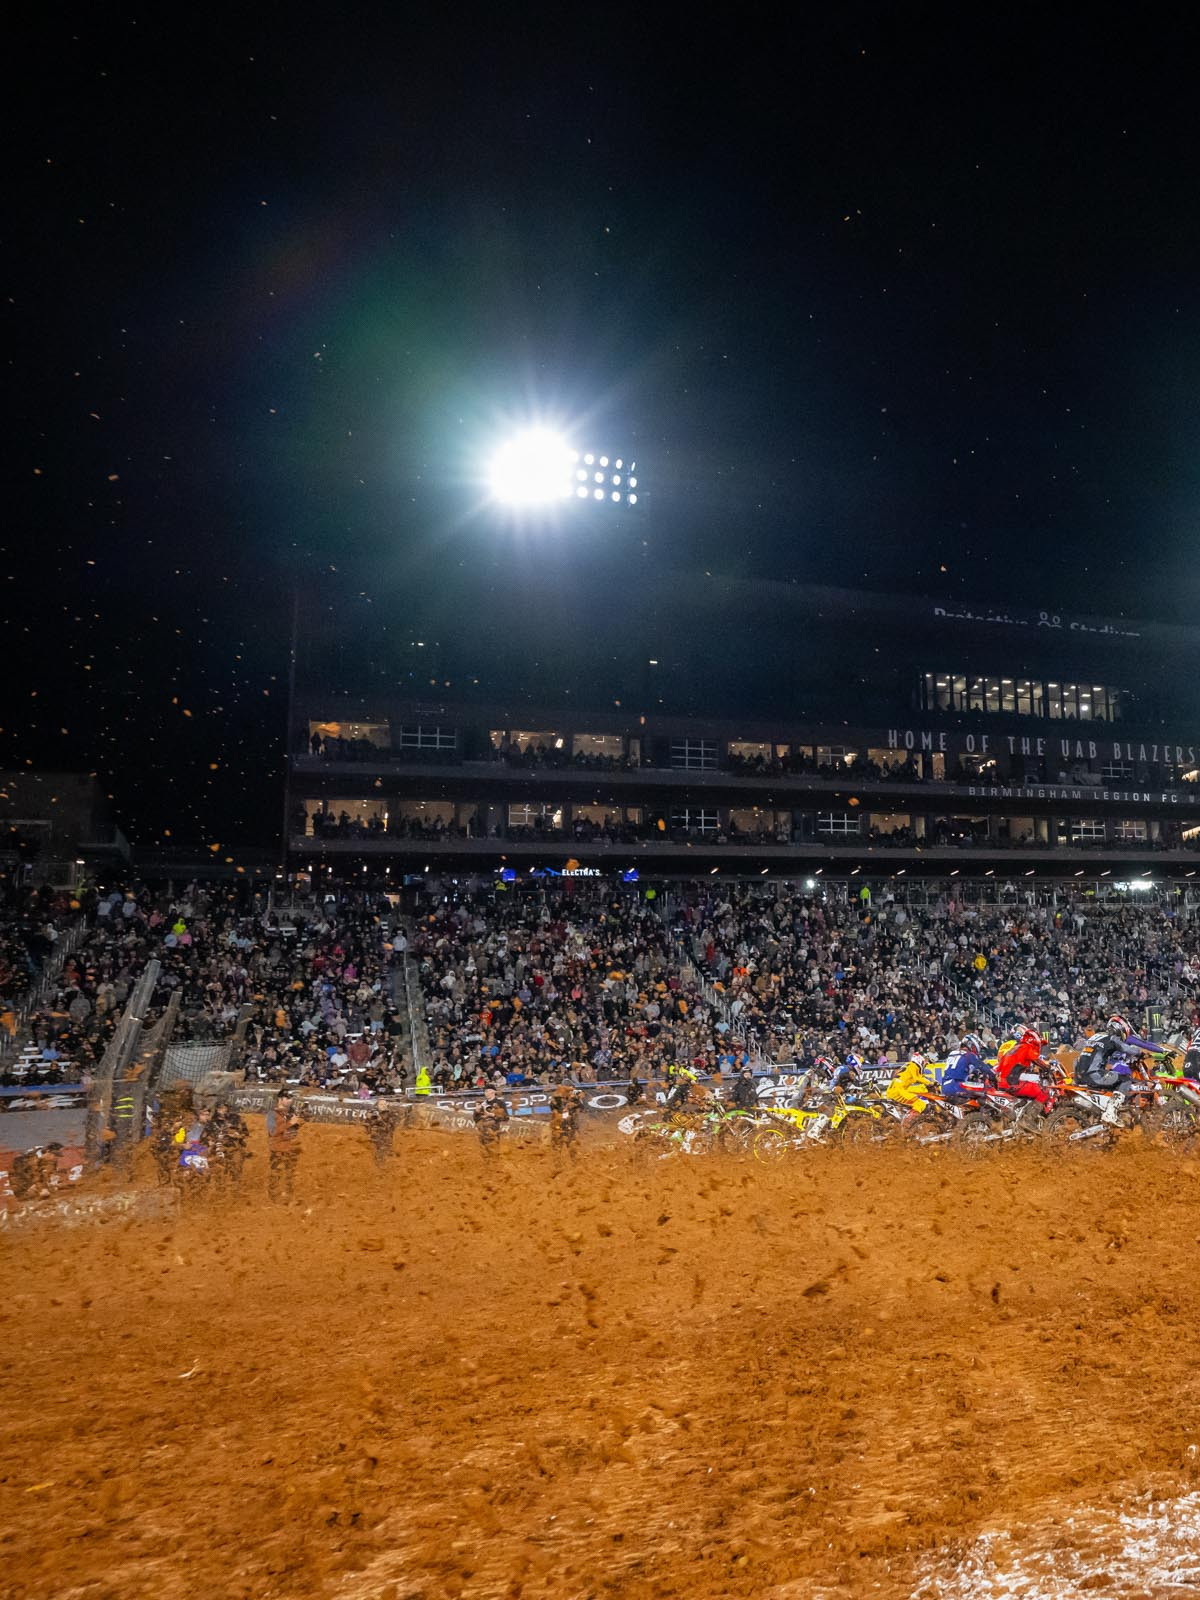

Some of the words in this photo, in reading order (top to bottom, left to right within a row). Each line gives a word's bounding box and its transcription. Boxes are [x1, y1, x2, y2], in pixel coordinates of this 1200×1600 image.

[888, 729, 947, 751] HOME
[966, 733, 989, 753] OF
[1008, 736, 1045, 757] THE
[1061, 739, 1097, 760] UAB
[1113, 742, 1196, 763] BLAZERS
[968, 786, 1082, 800] BIRMINGHAM
[1093, 790, 1151, 803] LEGION
[1161, 793, 1178, 804] FC
